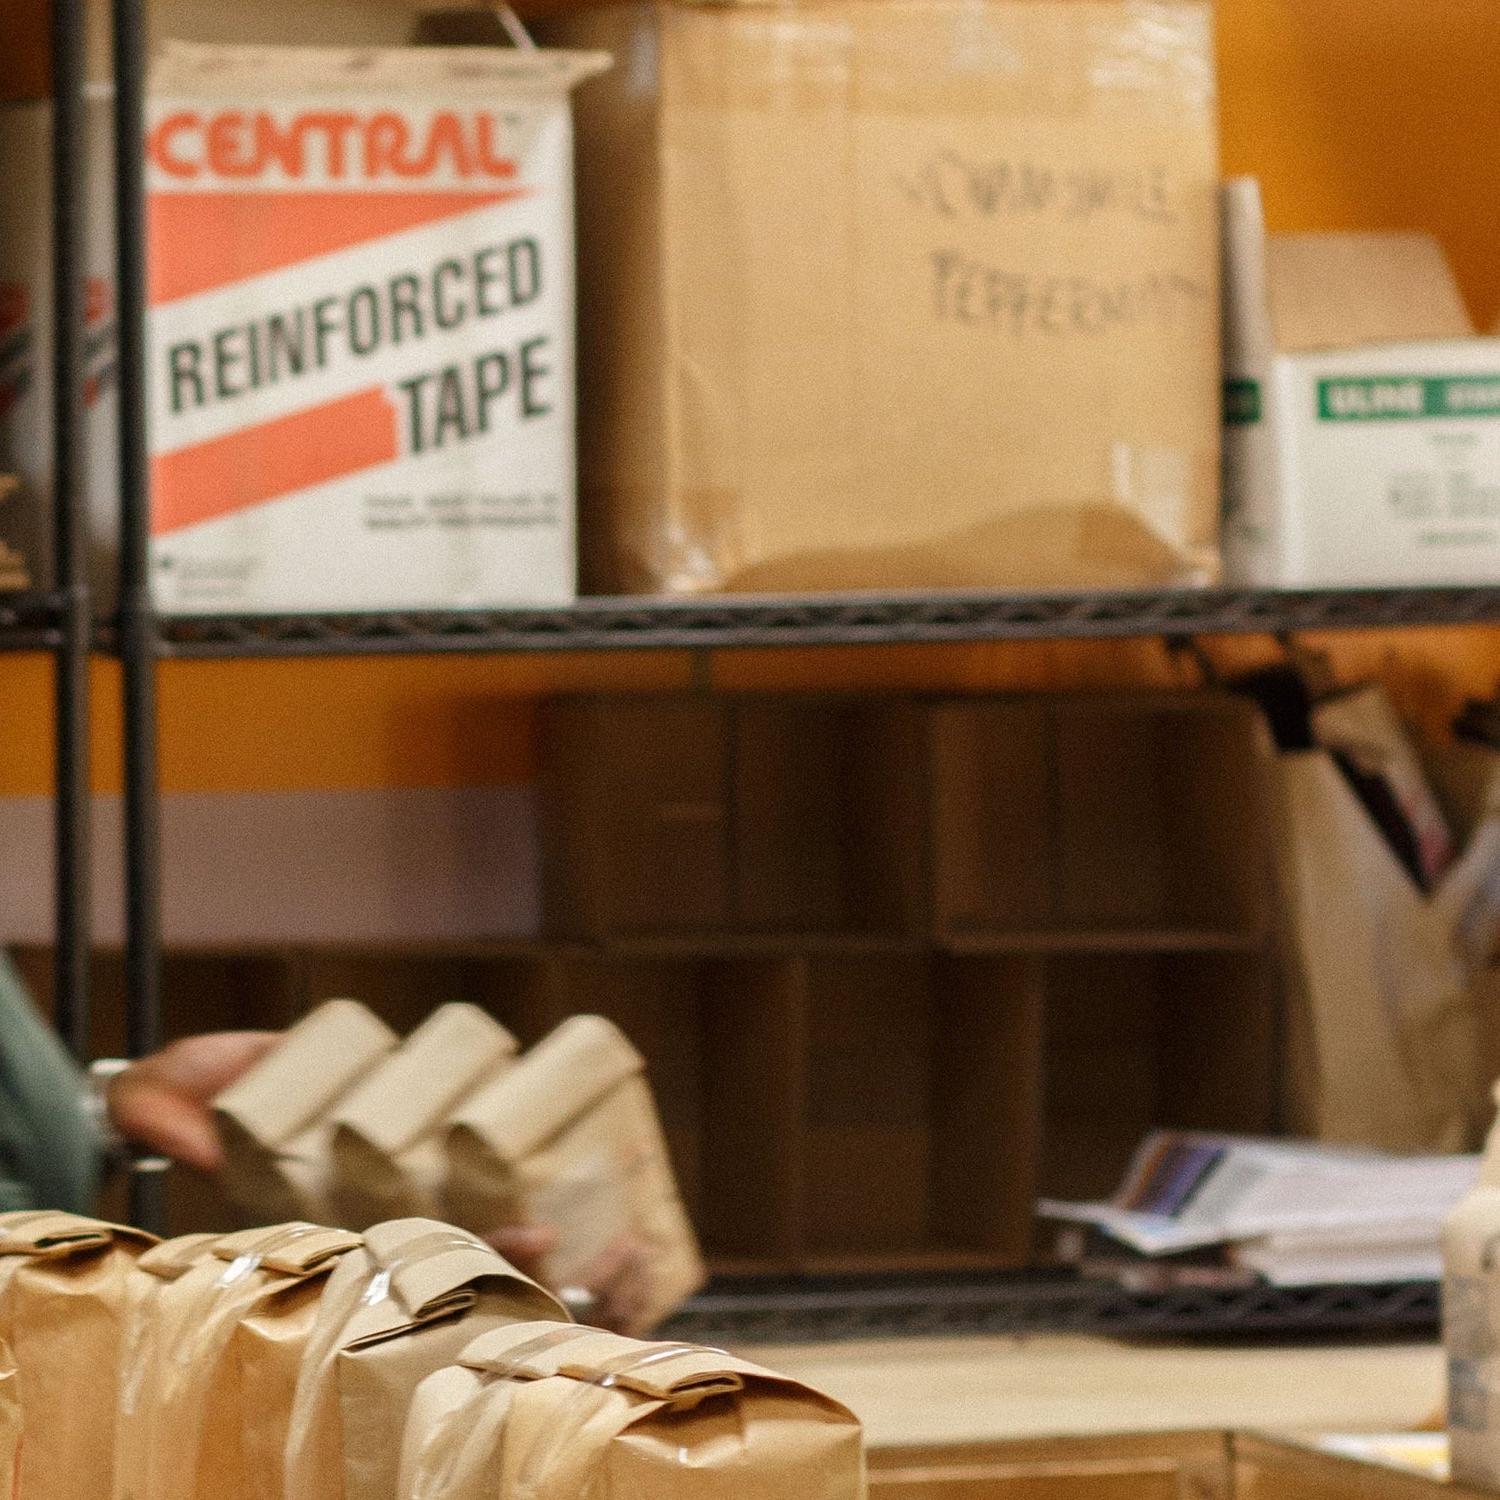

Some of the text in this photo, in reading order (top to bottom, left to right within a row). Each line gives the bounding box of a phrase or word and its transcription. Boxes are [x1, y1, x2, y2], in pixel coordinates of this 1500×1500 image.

[147, 111, 518, 179] CENTRAL
[167, 235, 544, 418] REINFORCED
[399, 335, 553, 458] TAPE
